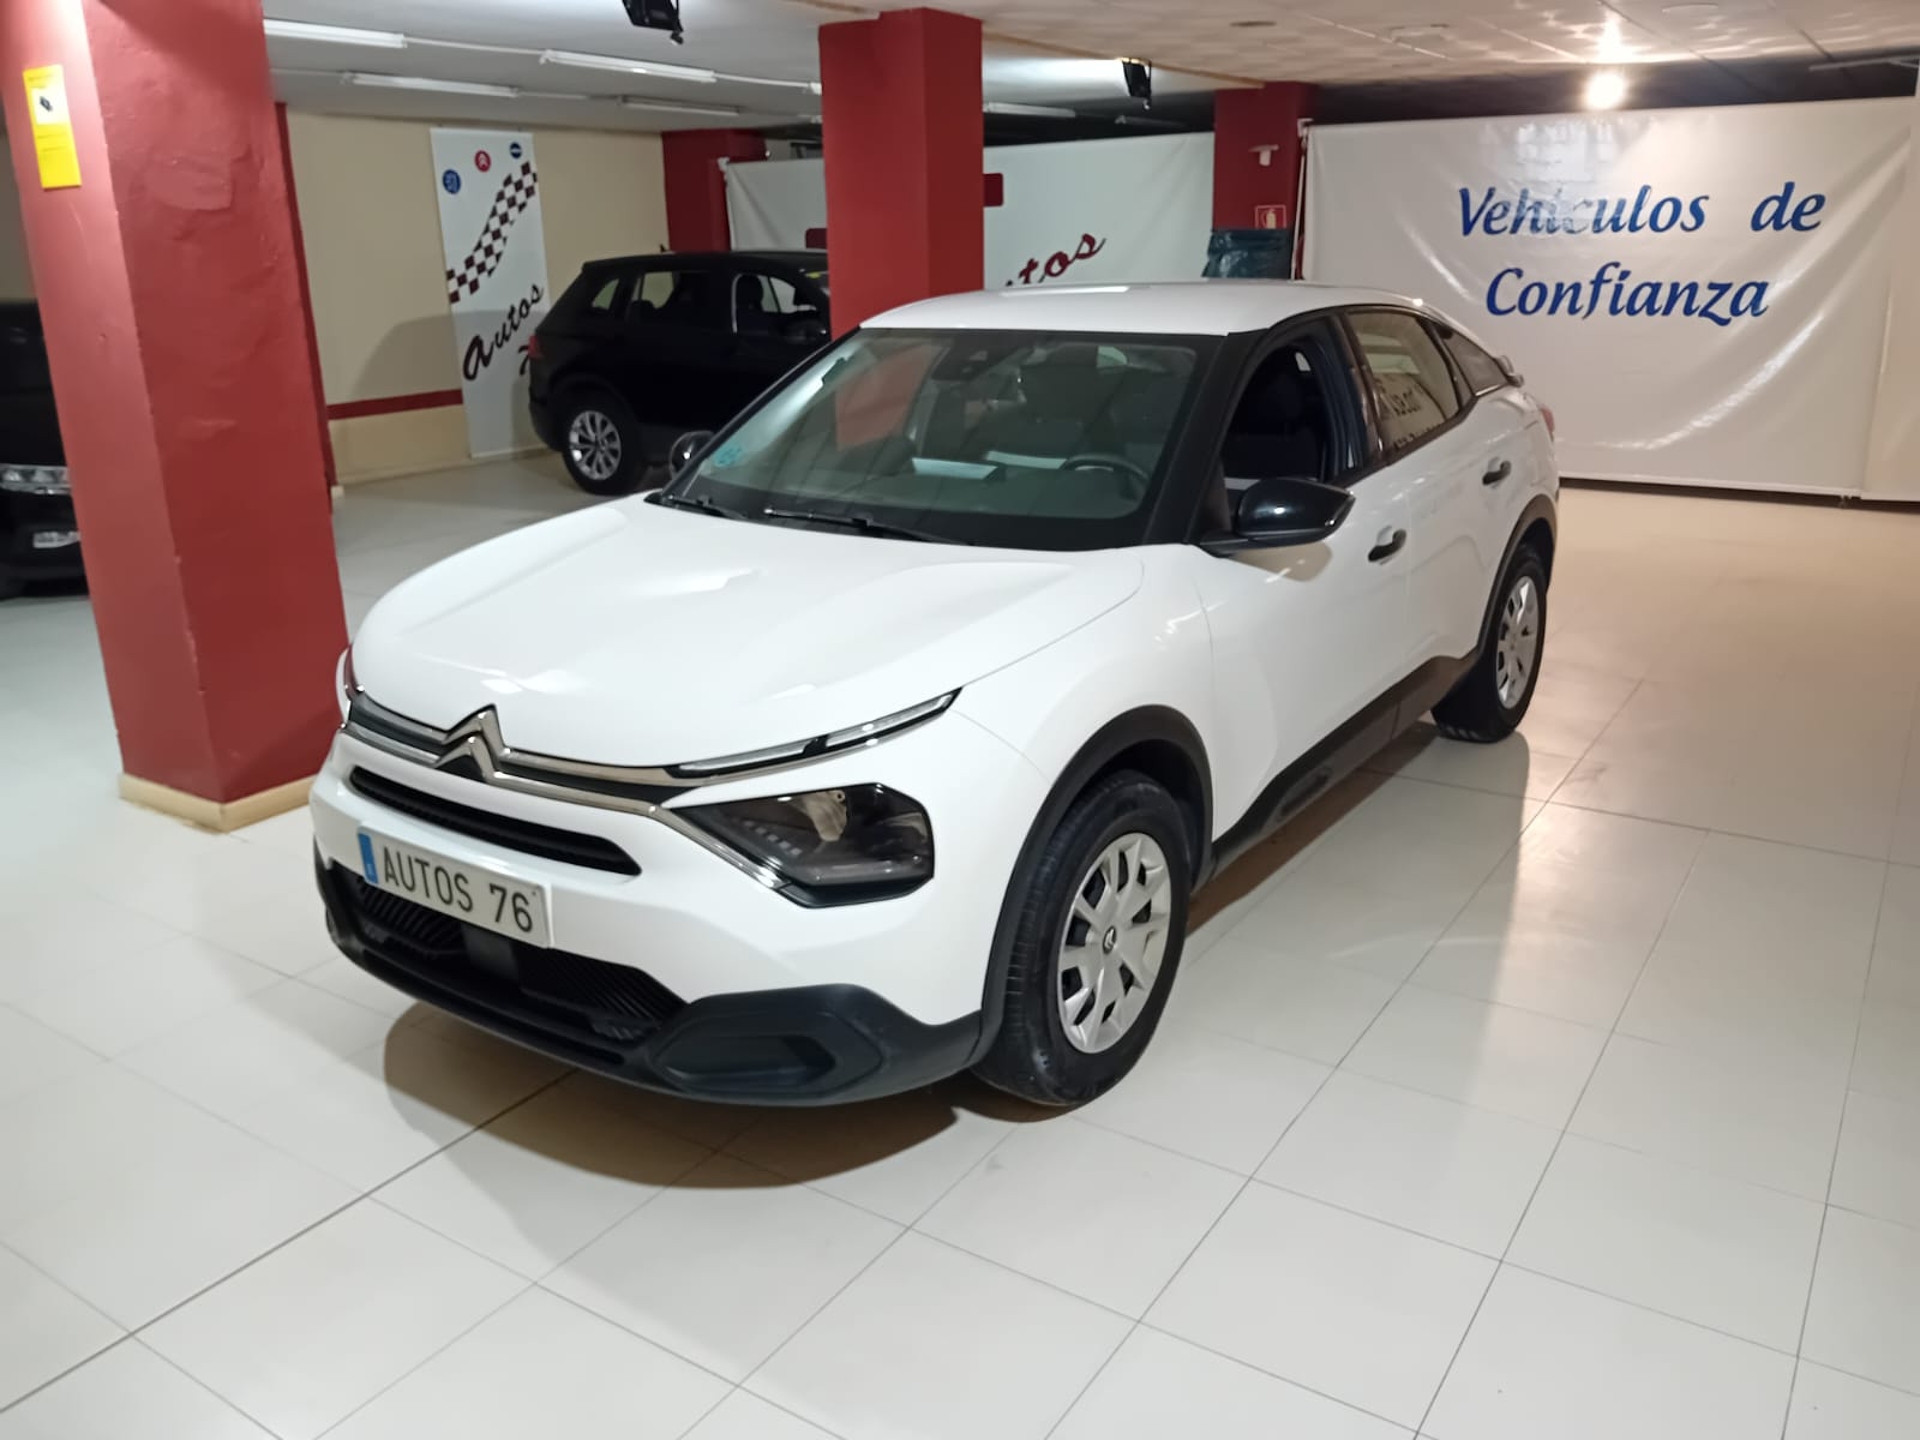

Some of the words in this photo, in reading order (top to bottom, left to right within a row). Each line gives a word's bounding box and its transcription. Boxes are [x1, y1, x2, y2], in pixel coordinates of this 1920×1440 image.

[1750, 181, 1826, 232] de
[1486, 261, 1769, 326] Confianza
[383, 846, 474, 913] AUTOS
[489, 882, 533, 933] 76
